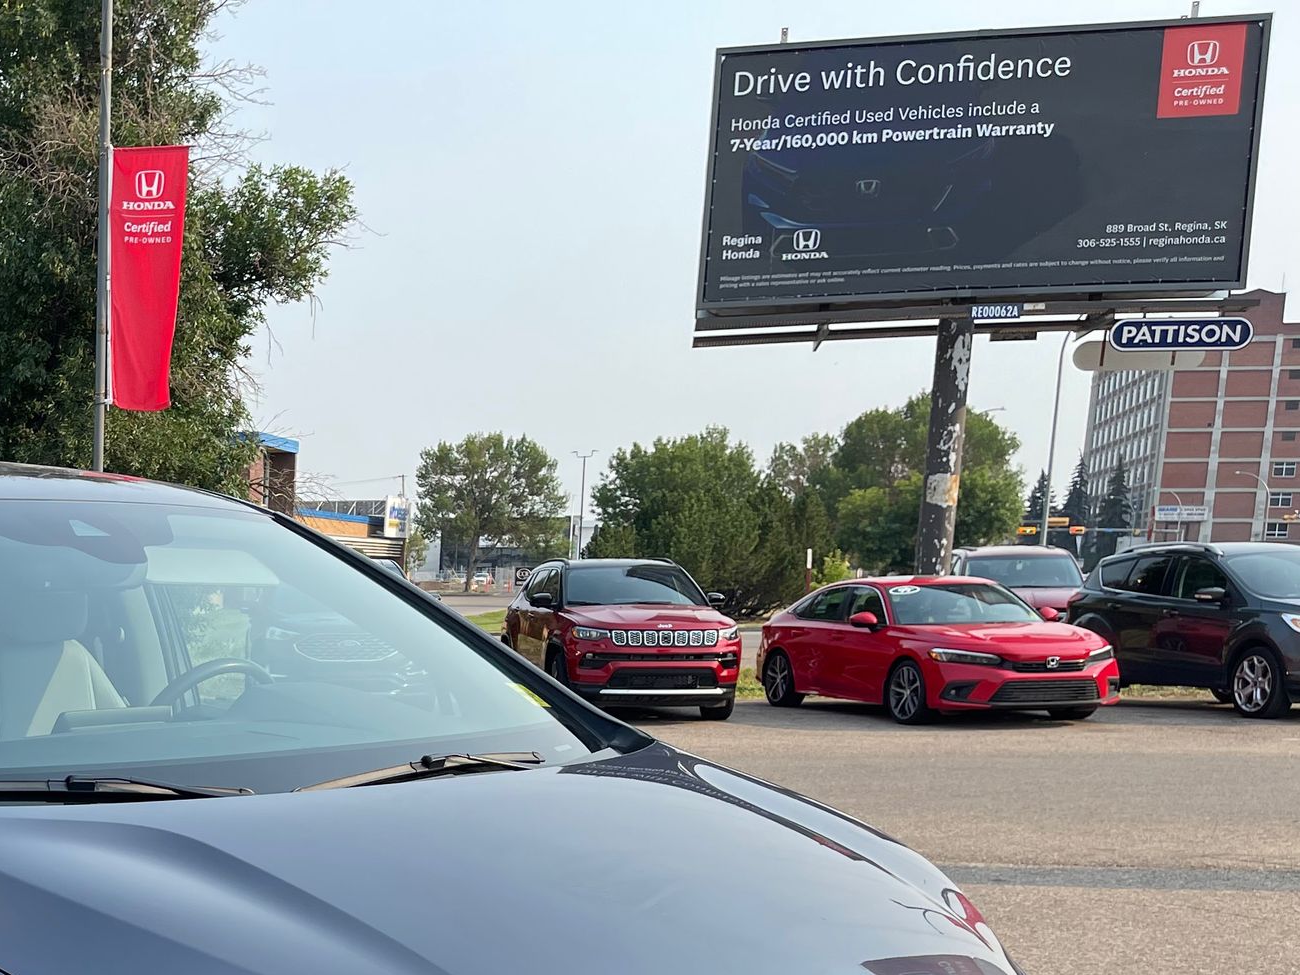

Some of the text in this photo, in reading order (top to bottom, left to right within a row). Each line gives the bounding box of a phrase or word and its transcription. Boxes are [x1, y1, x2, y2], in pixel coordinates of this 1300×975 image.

[734, 53, 1071, 96] Drive with Confidence
[1172, 66, 1229, 77] HONDA
[1174, 84, 1225, 98] Certified
[731, 100, 1040, 132] Honda Certified Used Vehicles include a
[730, 120, 1055, 152] 7-Year/160,000 km Powertrain Warranty
[122, 200, 176, 211] HONDA
[124, 221, 172, 235] Certified
[1106, 224, 1125, 234] 889
[1127, 222, 1156, 233] Broad
[1174, 220, 1212, 233] Regina,
[1214, 220, 1228, 230] SK
[124, 236, 172, 244] PRE-OWNED
[722, 234, 762, 248] Regina
[1076, 237, 1140, 248] 306-525-1555
[1148, 234, 1226, 248] reginahonda.ca
[722, 248, 760, 260] Honda
[782, 251, 829, 261] HONDA
[971, 305, 1018, 318] RE00062A
[1121, 324, 1242, 344] PATTISON
